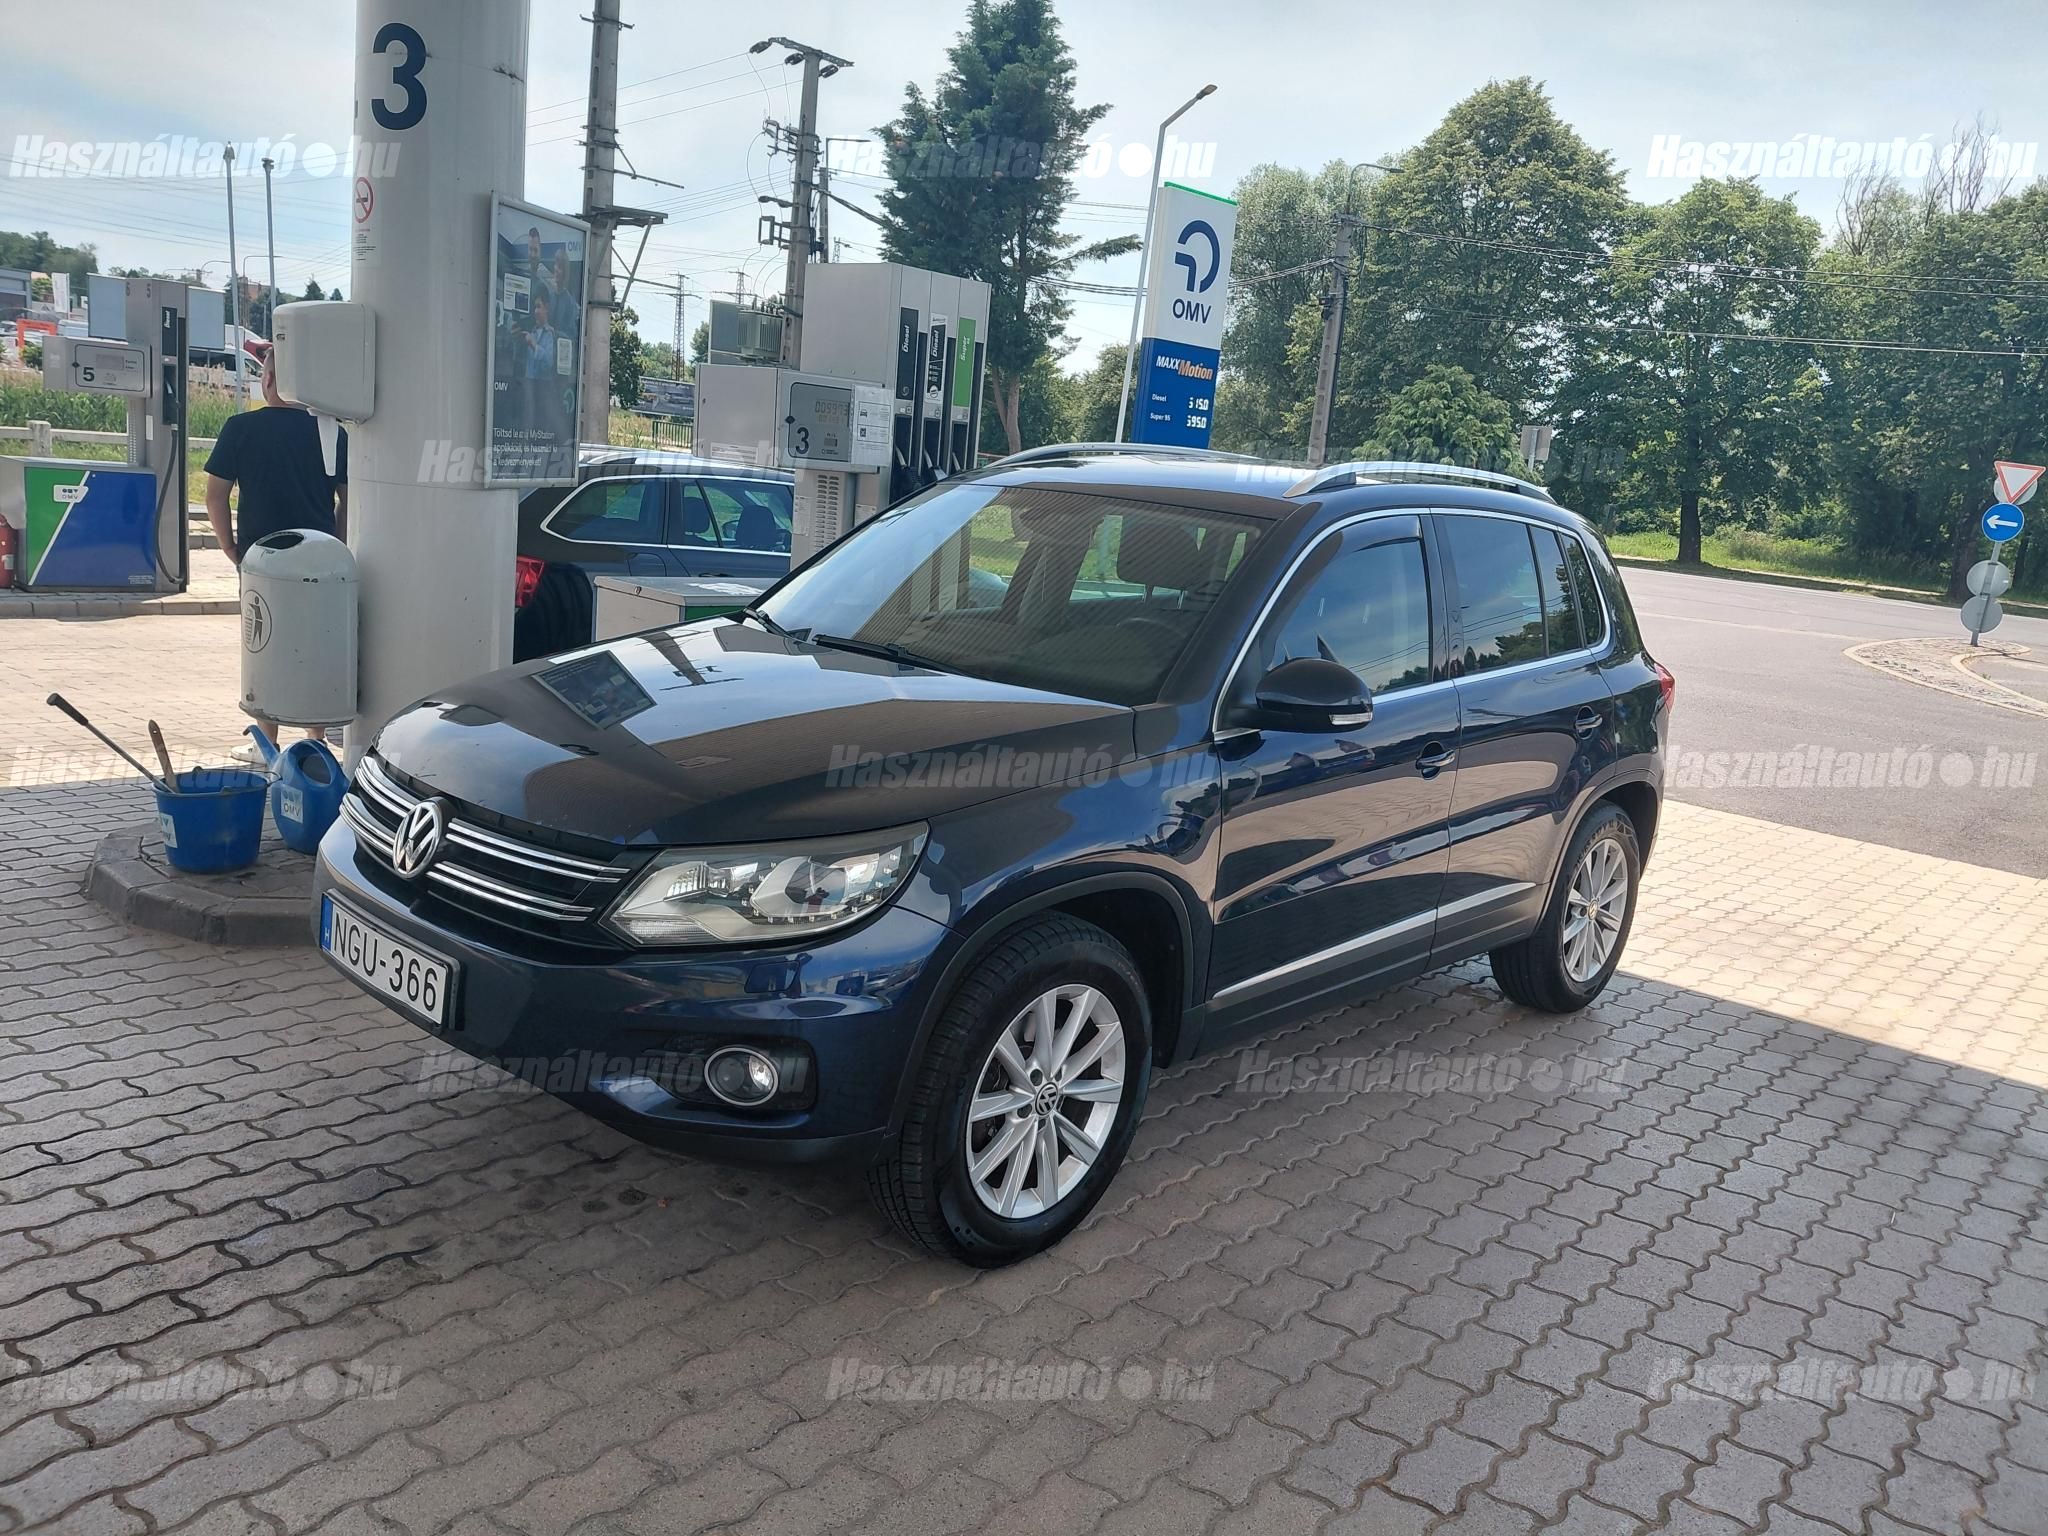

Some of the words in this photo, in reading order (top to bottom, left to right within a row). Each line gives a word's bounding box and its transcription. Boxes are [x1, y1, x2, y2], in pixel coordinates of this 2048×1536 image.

[371, 22, 428, 131] 3
[1172, 298, 1212, 324] OMV
[901, 325, 910, 353] Diesel
[932, 329, 940, 357] Diesel
[82, 366, 95, 382] 5
[494, 382, 509, 391] OMV
[1151, 393, 1167, 402] Diesel
[1150, 412, 1164, 421] Super
[795, 427, 809, 455] 3
[283, 802, 300, 817] OMV
[324, 926, 330, 944] H
[333, 911, 439, 1013] NGU-366
